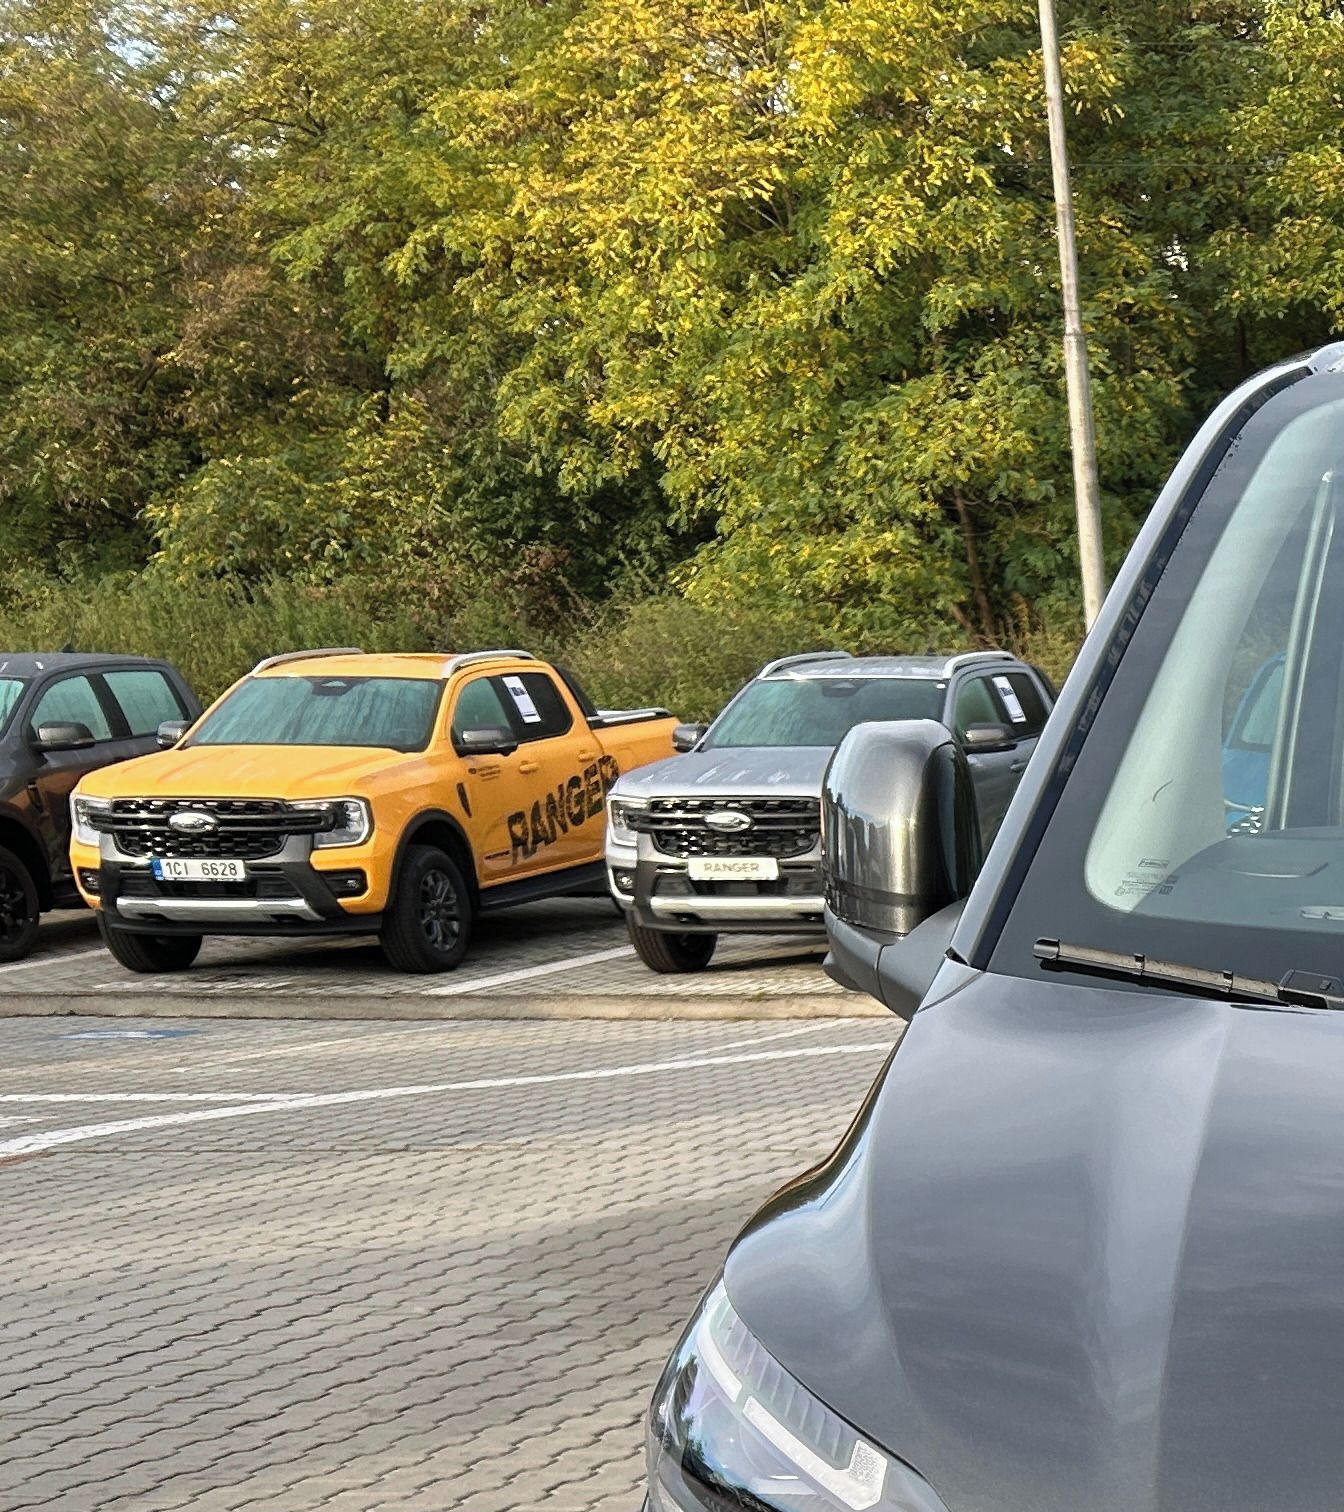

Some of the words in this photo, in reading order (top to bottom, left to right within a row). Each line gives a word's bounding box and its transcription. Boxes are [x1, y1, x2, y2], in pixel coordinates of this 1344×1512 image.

[508, 755, 620, 865] RANGER
[166, 862, 189, 876] 1CI
[201, 862, 238, 877] 6628
[704, 863, 760, 873] RANGER
